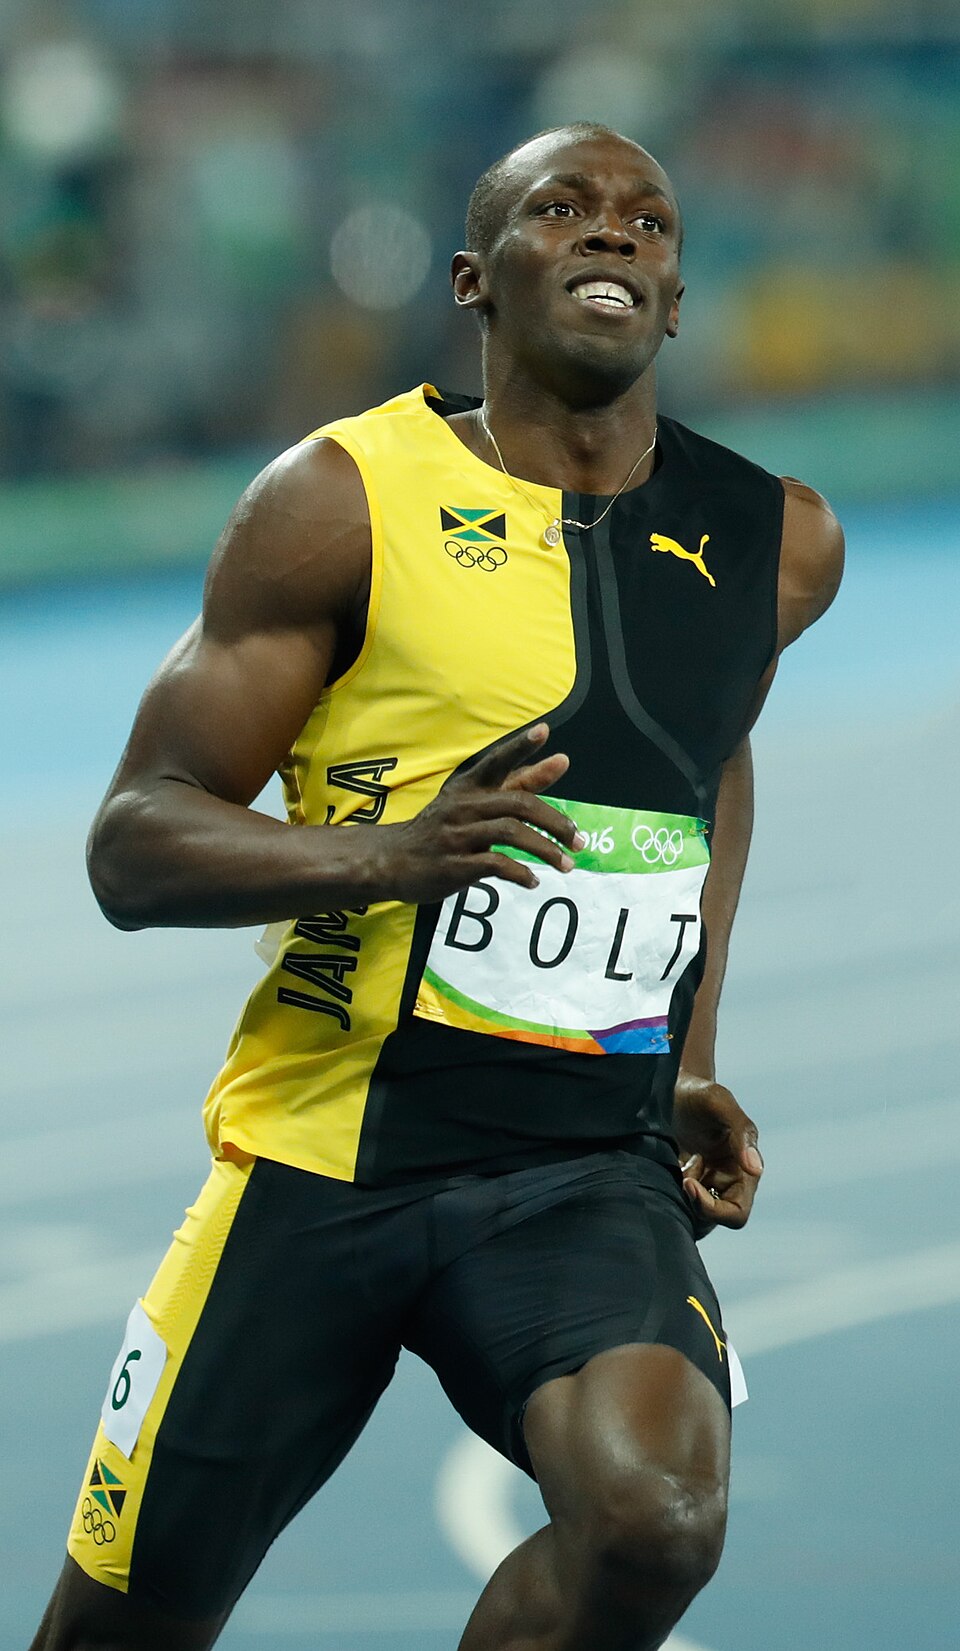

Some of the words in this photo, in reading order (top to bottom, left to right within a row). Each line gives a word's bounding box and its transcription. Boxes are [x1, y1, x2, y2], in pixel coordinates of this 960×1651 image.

[277, 757, 398, 1031] JAMA
[444, 880, 697, 981] BOLT
[111, 1349, 142, 1411] 6
